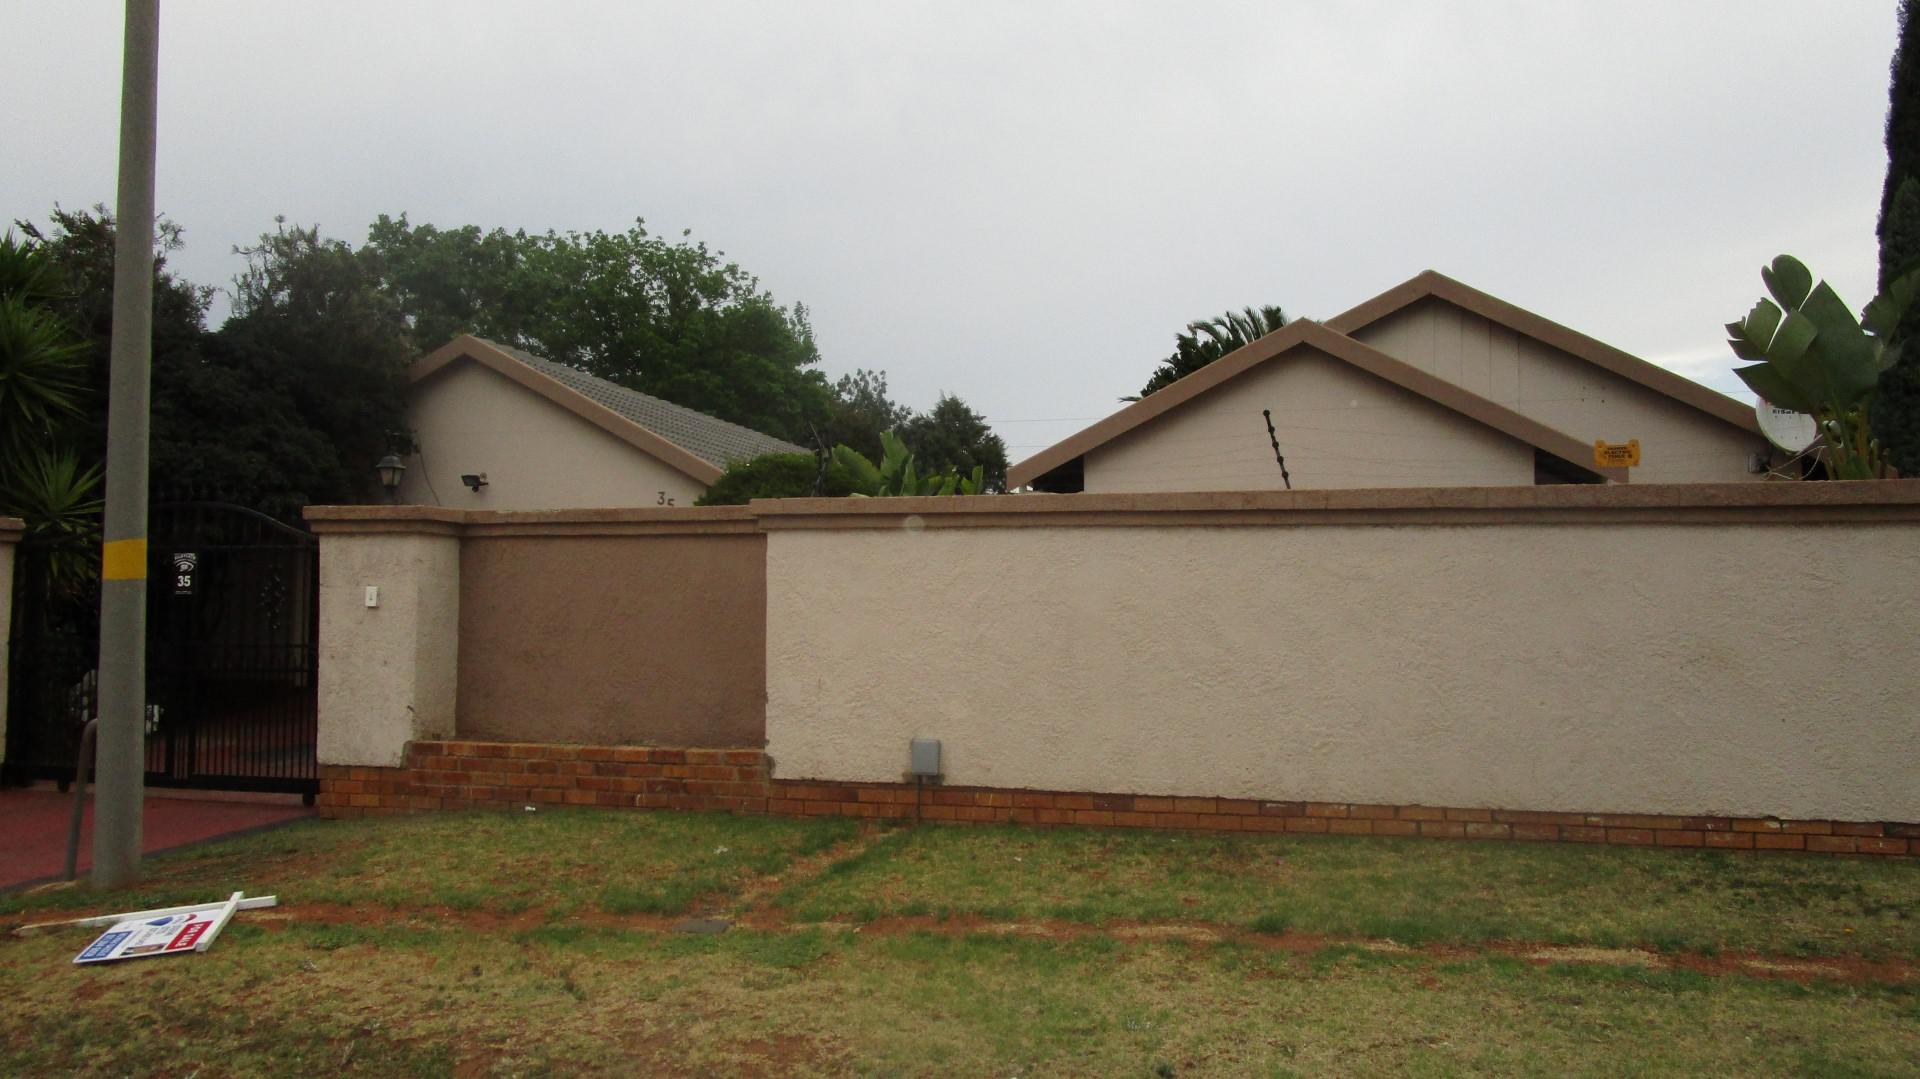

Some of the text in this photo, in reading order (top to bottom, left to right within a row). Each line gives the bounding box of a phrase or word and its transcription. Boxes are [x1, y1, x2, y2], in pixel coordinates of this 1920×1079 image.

[177, 575, 191, 587] 35
[186, 923, 204, 934] FOR
[174, 933, 195, 947] SALE
